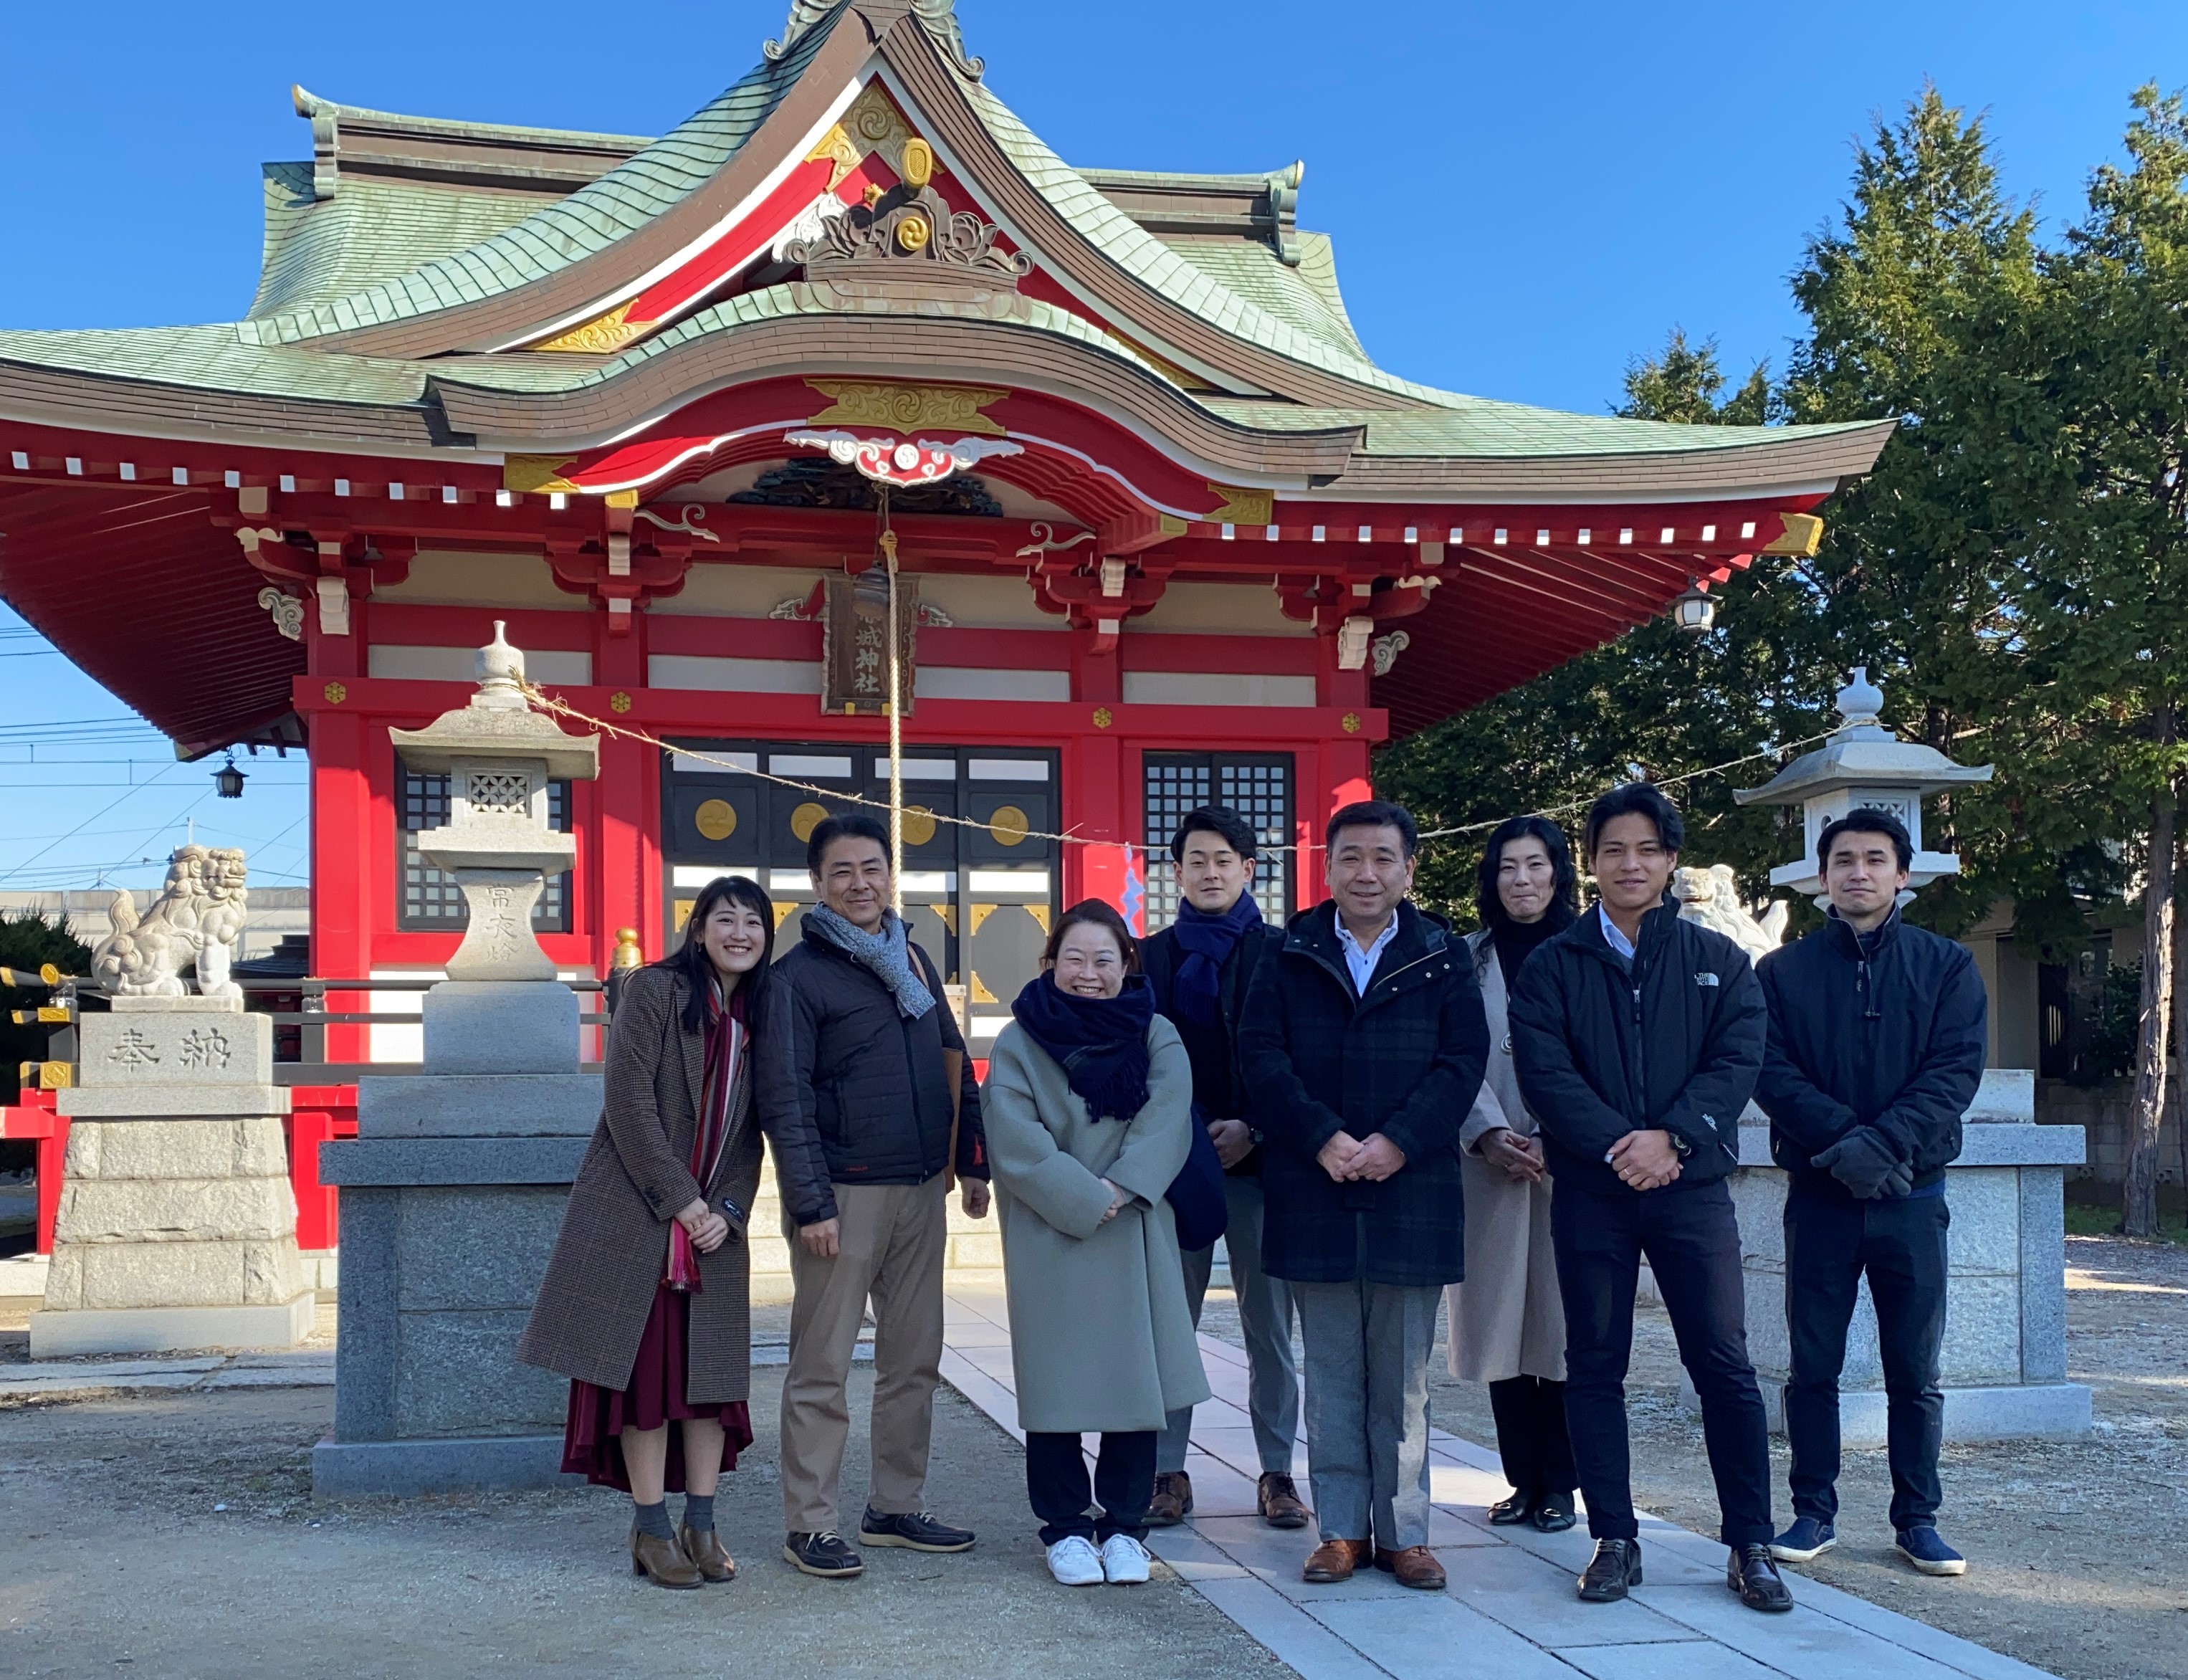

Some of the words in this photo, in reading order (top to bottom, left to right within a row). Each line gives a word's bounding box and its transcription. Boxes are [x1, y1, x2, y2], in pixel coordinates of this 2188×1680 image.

[855, 616, 882, 693] 城神社
[108, 1027, 231, 1073] 奉納
